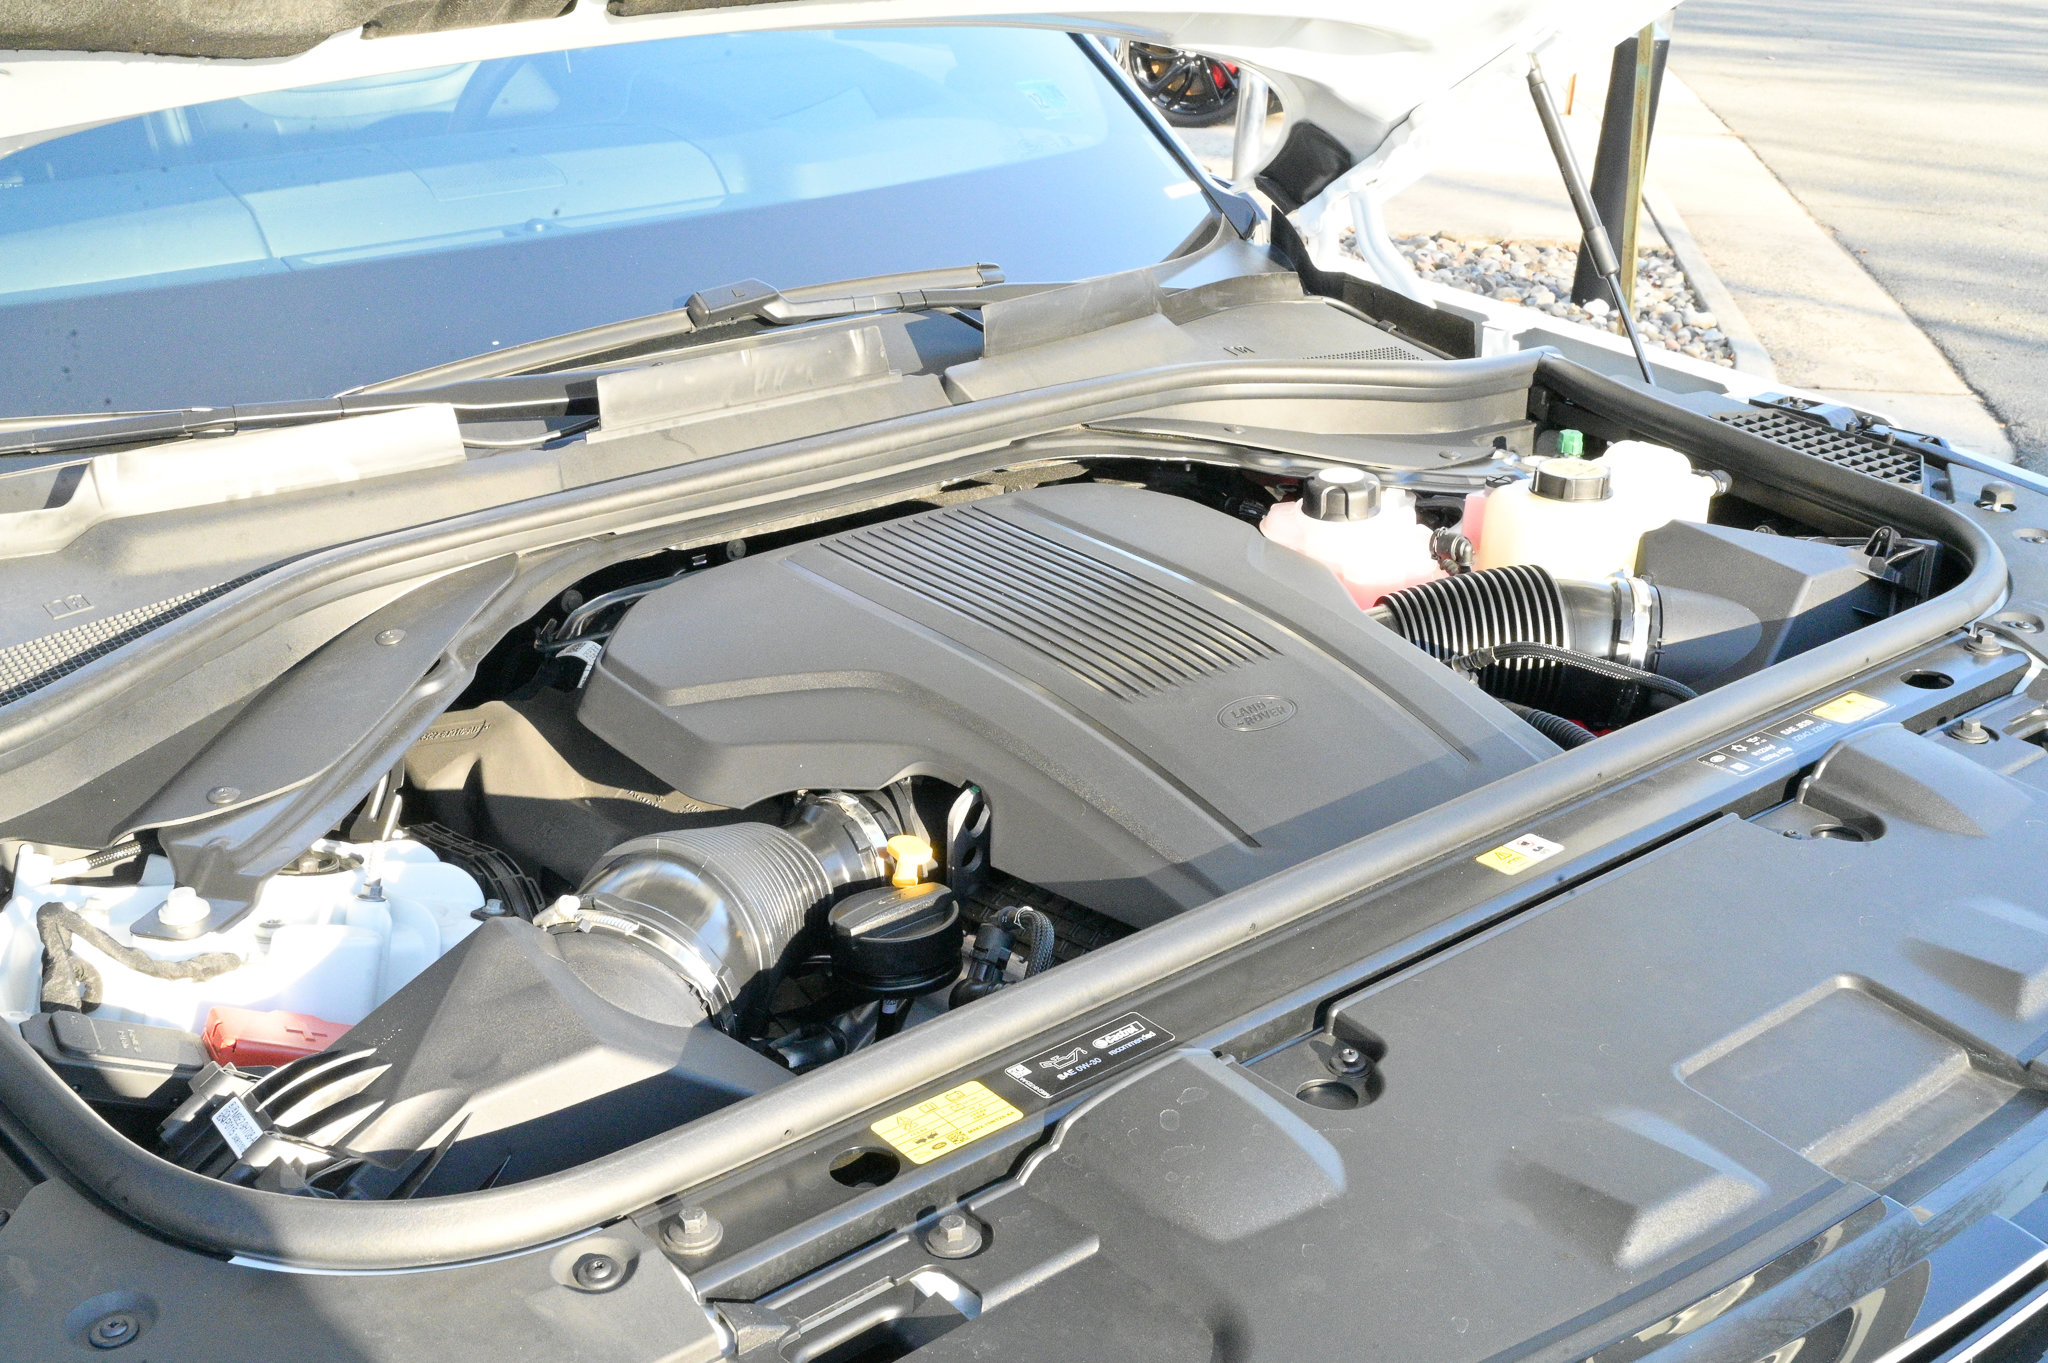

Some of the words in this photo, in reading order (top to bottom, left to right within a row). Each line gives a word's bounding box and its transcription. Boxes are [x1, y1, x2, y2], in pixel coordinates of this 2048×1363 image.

[1230, 701, 1266, 719] LAND
[1243, 705, 1287, 726] ROVER
[1105, 1025, 1138, 1044] Castrol
[1108, 1030, 1157, 1056] recommended
[1056, 1068, 1078, 1081] SAE
